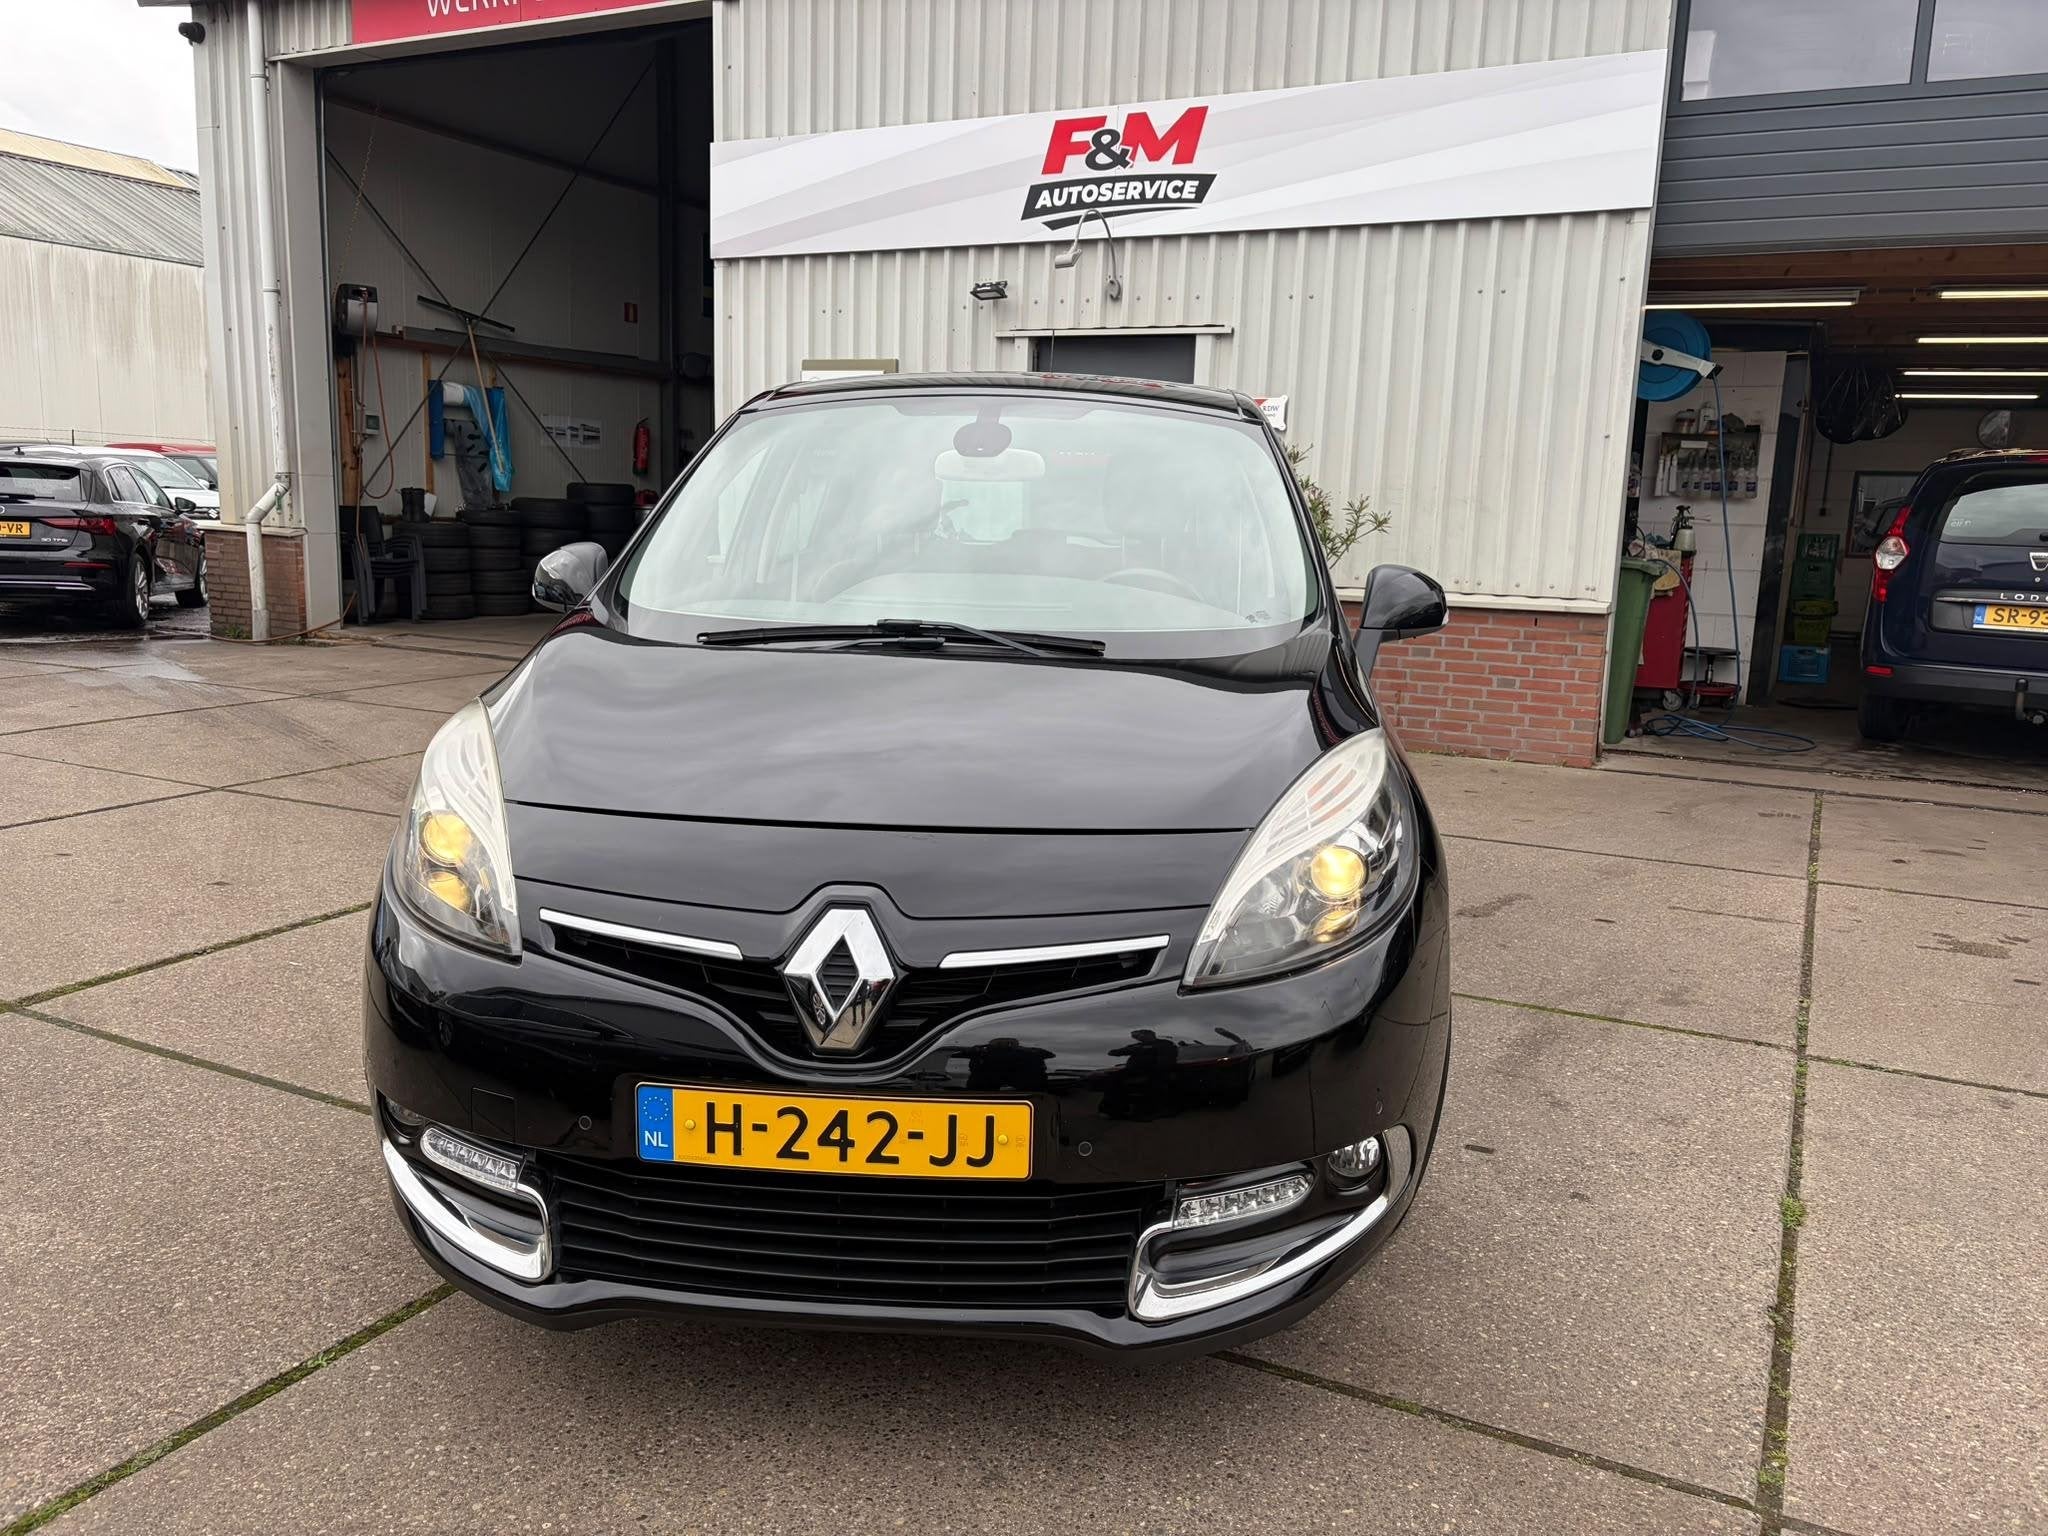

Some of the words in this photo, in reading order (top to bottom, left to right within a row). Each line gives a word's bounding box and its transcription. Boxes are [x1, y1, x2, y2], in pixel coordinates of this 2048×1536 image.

[1041, 105, 1209, 175] F&M
[1035, 180, 1199, 209] AUTOSERVICE
[0, 523, 23, 533] -VR
[2000, 593, 2048, 601] LOD
[645, 1130, 669, 1148] NL
[706, 1101, 995, 1168] H-242-JJ
